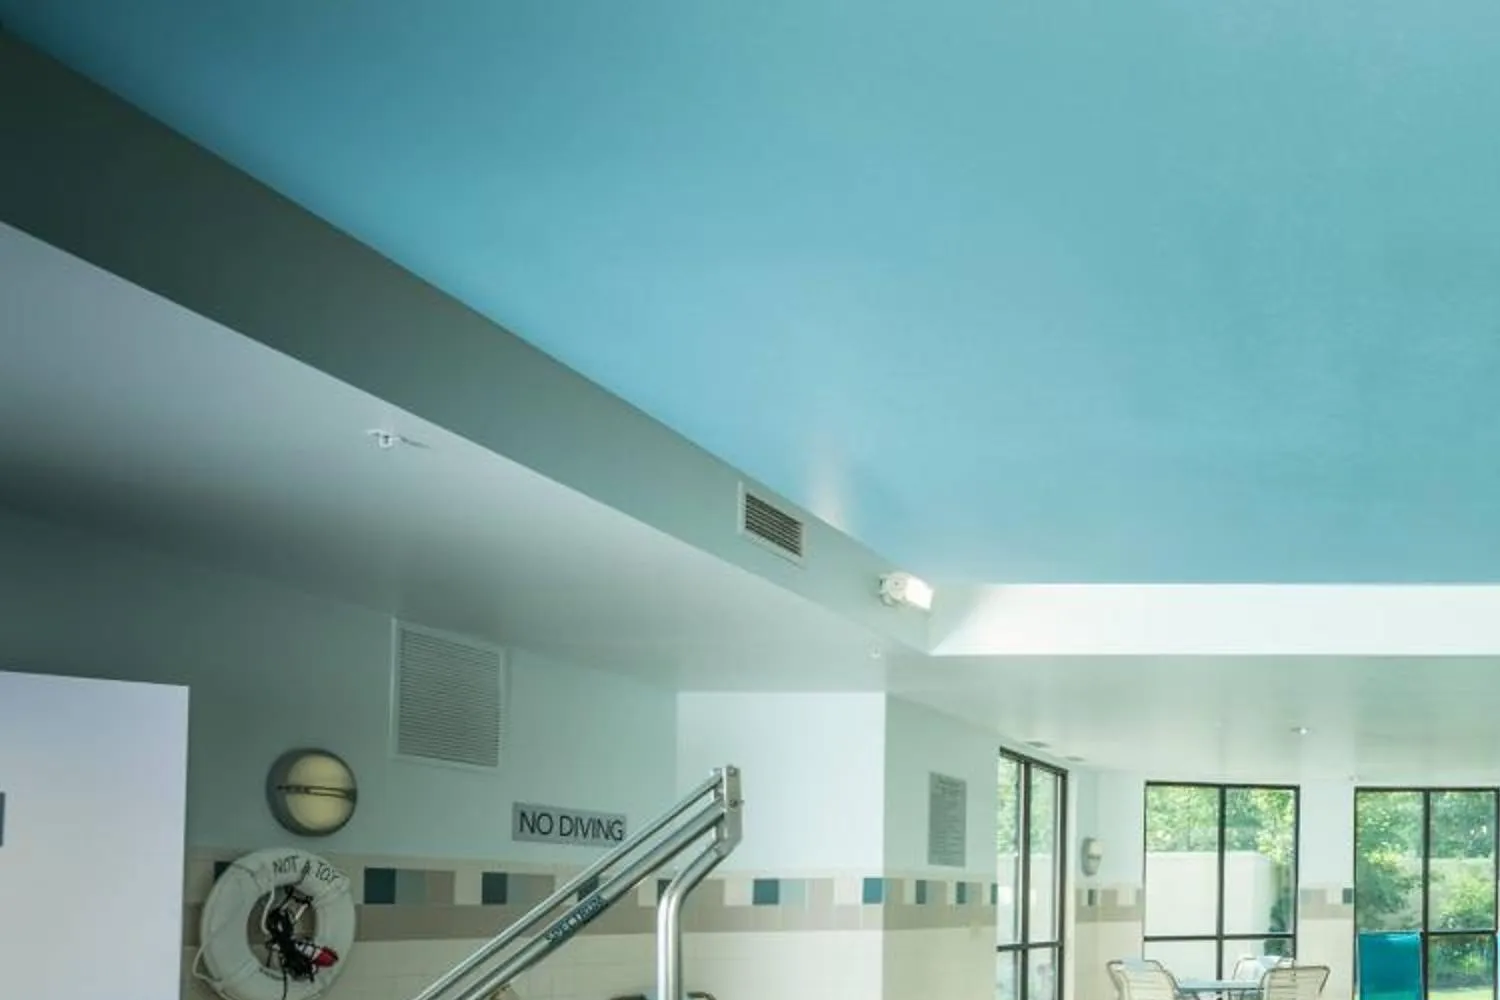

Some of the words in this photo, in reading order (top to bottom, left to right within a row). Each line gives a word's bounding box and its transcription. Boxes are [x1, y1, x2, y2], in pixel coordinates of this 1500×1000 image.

[519, 810, 553, 835] NO
[559, 815, 623, 841] DIVING
[272, 855, 299, 874] NOT
[316, 861, 340, 882] TOY
